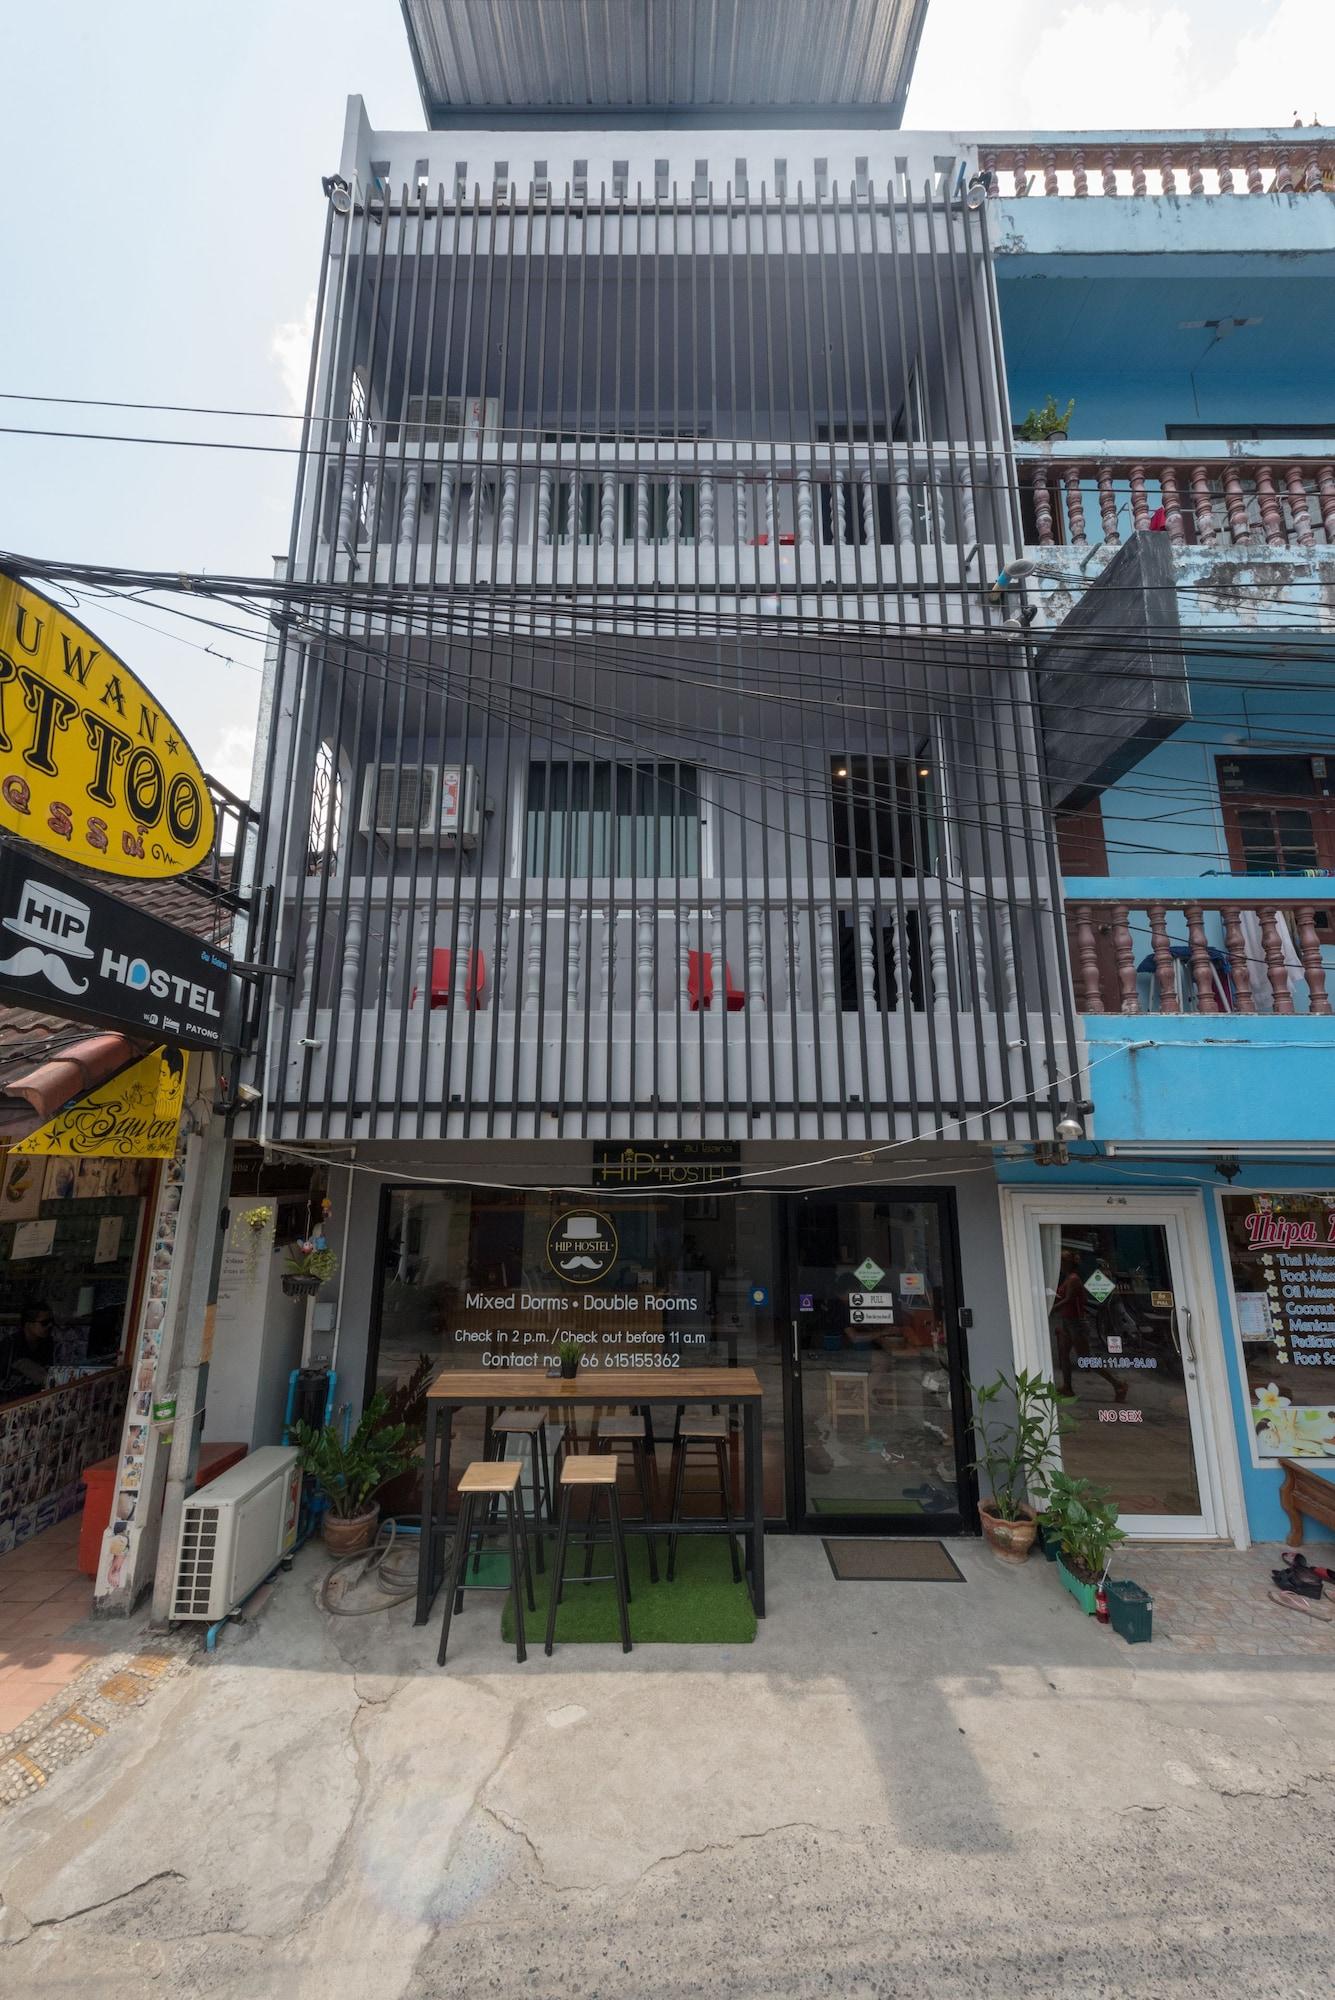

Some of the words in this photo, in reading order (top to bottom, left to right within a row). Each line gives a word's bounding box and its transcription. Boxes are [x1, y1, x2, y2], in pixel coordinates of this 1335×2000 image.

[24, 897, 85, 938] HIP
[100, 948, 220, 1018] HOSTEL
[185, 1022, 219, 1040] PATONG
[91, 1104, 177, 1140] Suwan
[1245, 1213, 1317, 1250] Thipa
[555, 1241, 572, 1252] HIP
[574, 1241, 611, 1252] HOSTEL
[1276, 1253, 1302, 1267] Thai
[1280, 1269, 1308, 1282] Foot
[1282, 1284, 1301, 1298] Oil
[466, 1293, 515, 1310] Mixed
[520, 1294, 569, 1311] Dorms
[583, 1295, 639, 1311] Double
[644, 1295, 698, 1311] Rooms
[870, 1295, 884, 1304] PULL
[455, 1330, 492, 1342] Check
[496, 1330, 508, 1342] in
[512, 1331, 520, 1342] 2
[602, 1331, 622, 1343] out
[626, 1331, 666, 1343] before
[669, 1331, 680, 1343] 11
[683, 1333, 706, 1343] a.m
[482, 1352, 538, 1367] Contact
[604, 1353, 680, 1368] 615155362
[1293, 1351, 1322, 1366] Foot
[1098, 1409, 1118, 1423] NO
[1119, 1409, 1143, 1423] SEX
